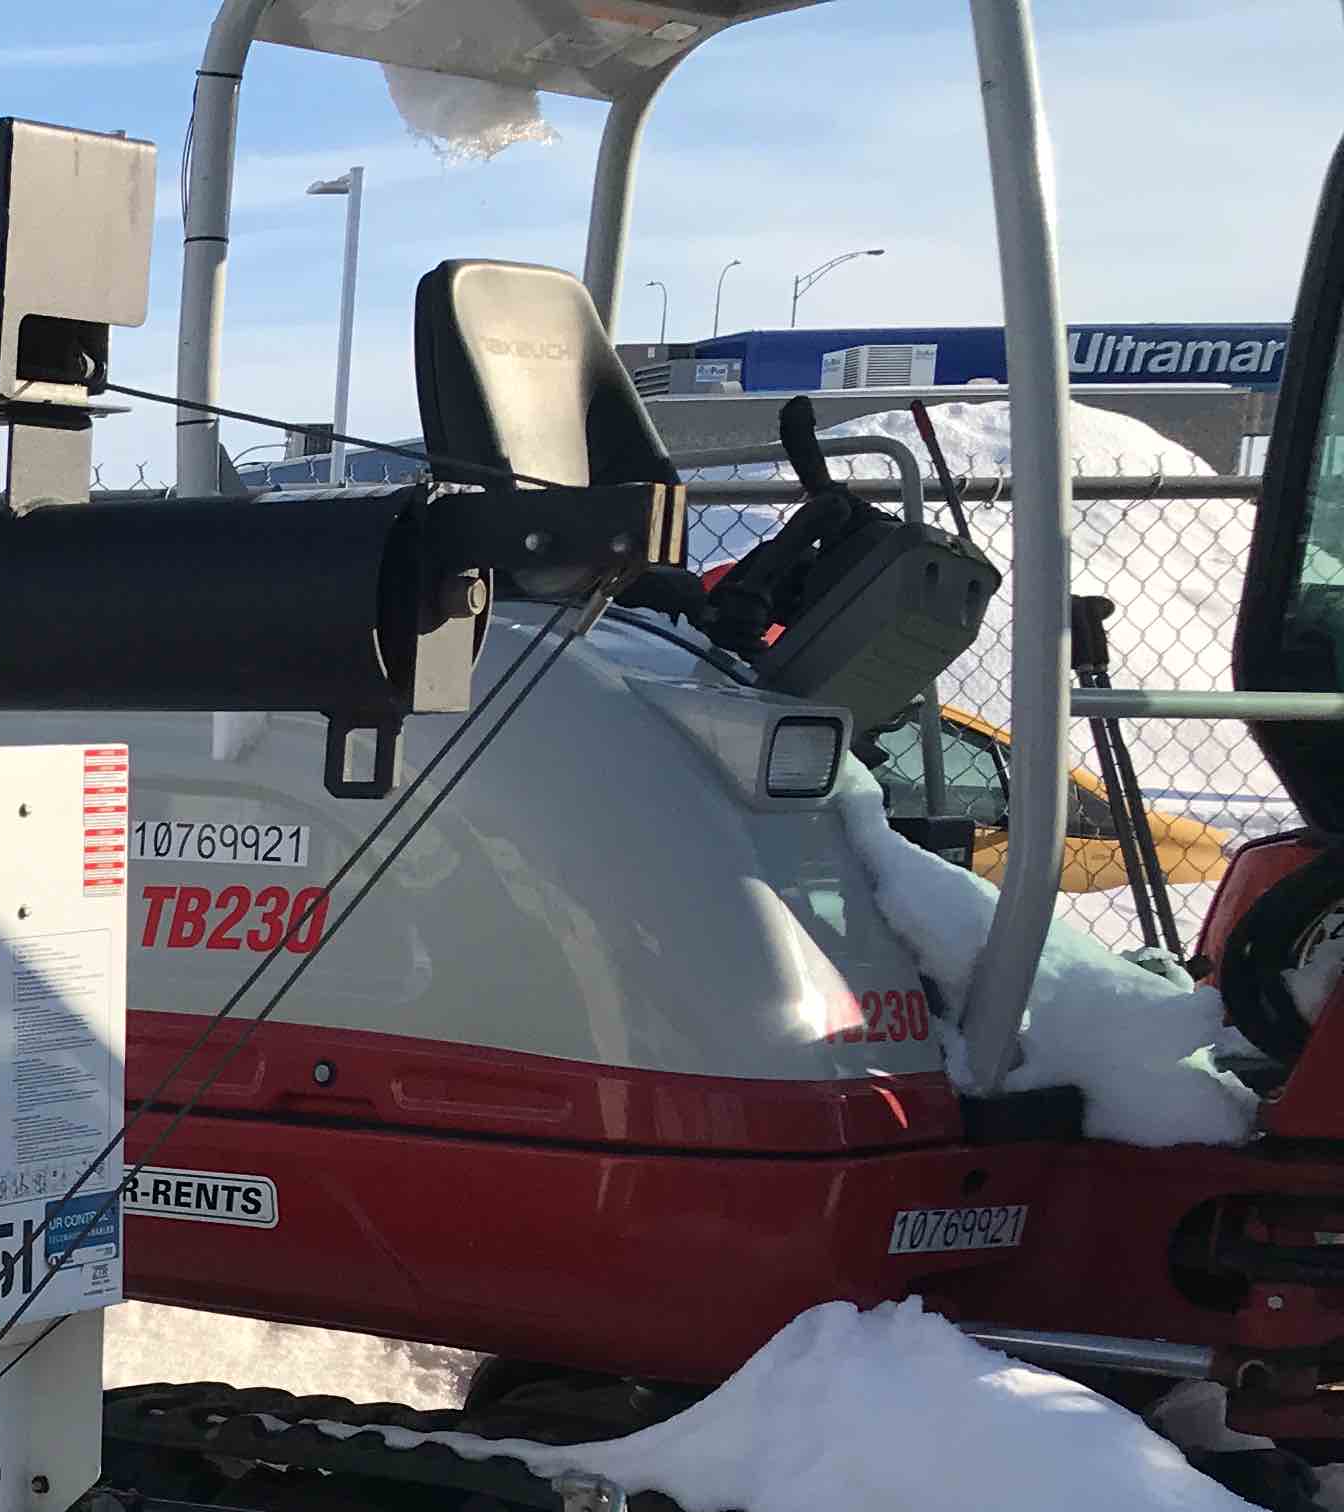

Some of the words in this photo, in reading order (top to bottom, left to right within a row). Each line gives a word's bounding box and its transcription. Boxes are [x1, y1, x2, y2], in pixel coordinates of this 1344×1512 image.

[1069, 332, 1285, 374] Ultramar
[135, 821, 301, 863] 10769921
[140, 885, 332, 954] TB230
[897, 1208, 1022, 1250] 10769921
